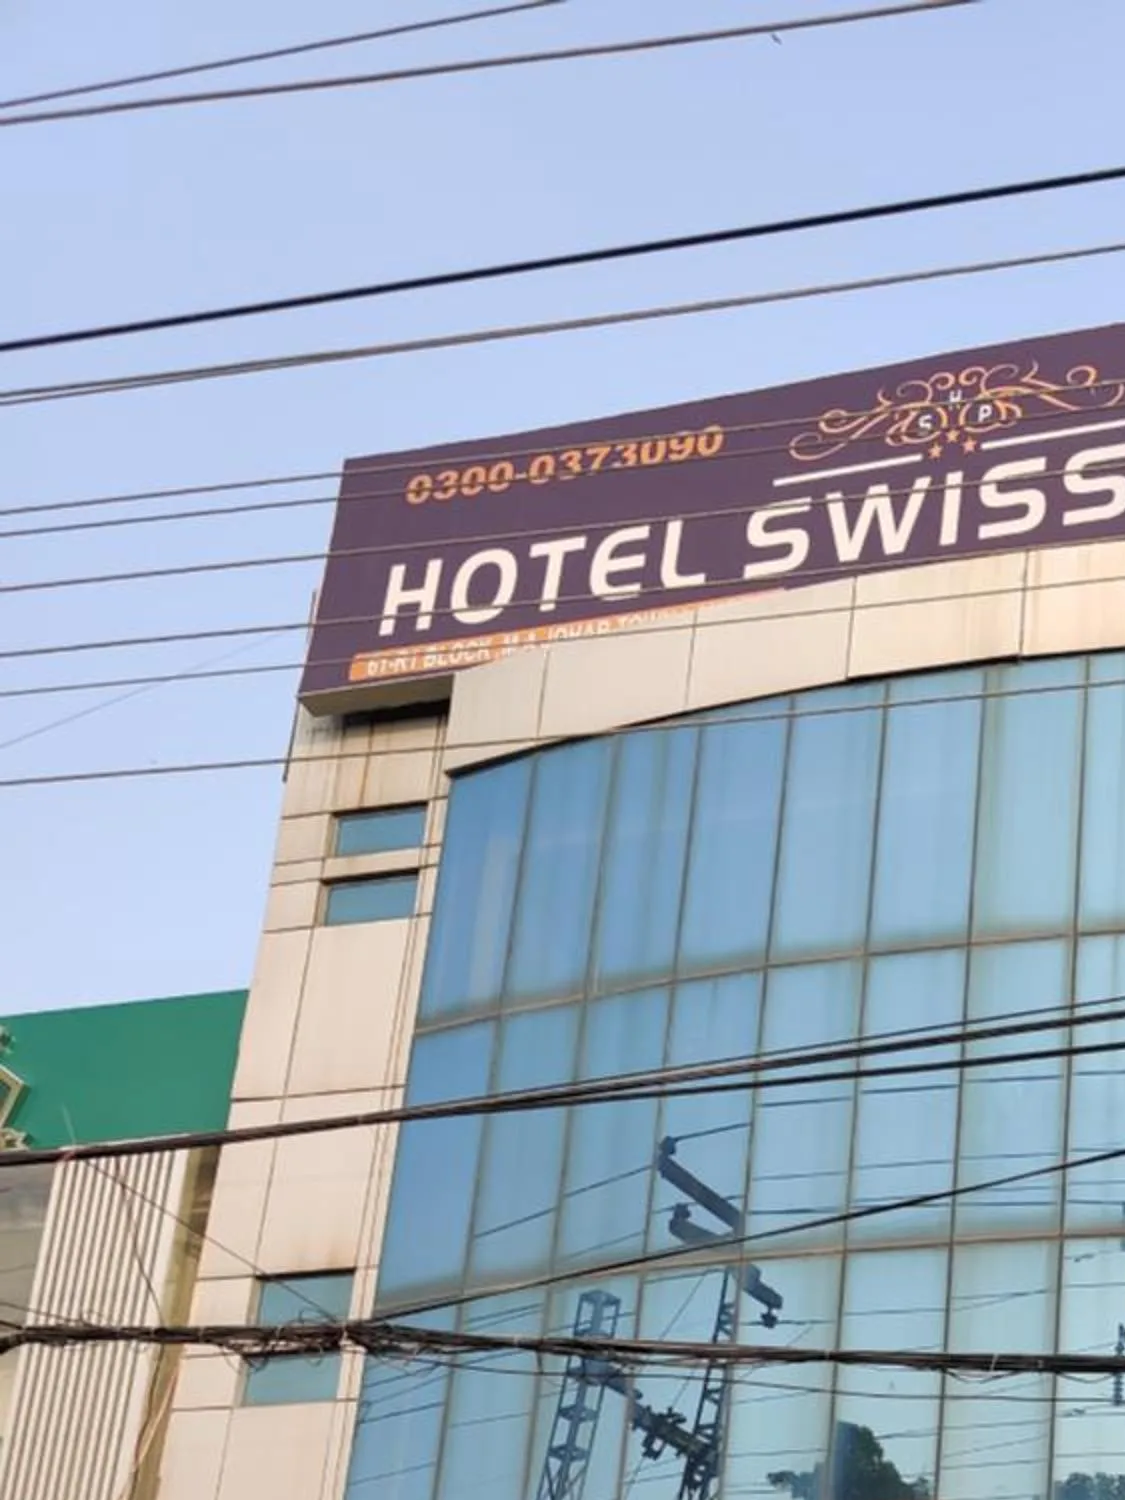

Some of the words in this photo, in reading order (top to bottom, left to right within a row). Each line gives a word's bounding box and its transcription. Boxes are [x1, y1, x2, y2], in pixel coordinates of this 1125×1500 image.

[977, 404, 992, 422] P
[406, 424, 725, 505] 0300-0373090
[379, 519, 706, 636] HOTEL
